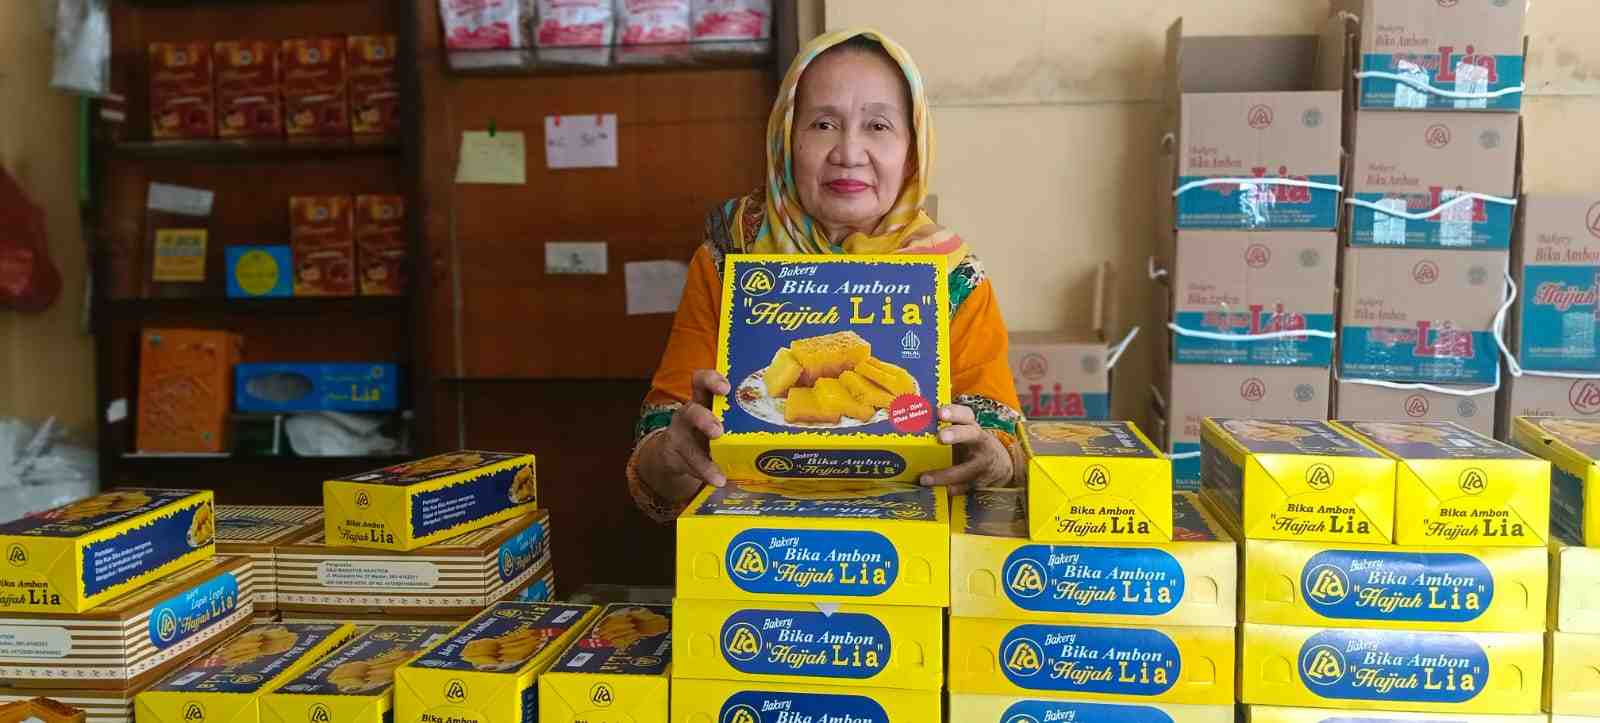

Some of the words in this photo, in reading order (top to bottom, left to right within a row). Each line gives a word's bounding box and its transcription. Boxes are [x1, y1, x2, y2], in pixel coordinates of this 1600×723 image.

[778, 265, 818, 278] Bakery
[780, 280, 828, 294] Bika
[834, 280, 911, 294] Ambon
[1029, 384, 1084, 417] Lia
[1070, 505, 1095, 515] Bika
[1098, 506, 1135, 516] Ambon
[1287, 503, 1314, 513] Bika
[1317, 504, 1356, 514] Ambon
[1440, 508, 1467, 517] Bika
[1470, 508, 1509, 517] Ambon
[1329, 515, 1370, 534] Lia
[1482, 518, 1524, 537] Lia
[371, 529, 394, 544] Lia
[768, 537, 800, 549] Bakery
[784, 548, 824, 561] Bika
[824, 550, 881, 562] Ambon
[1048, 552, 1079, 566] Bakery
[1063, 565, 1102, 578] Bika
[1106, 568, 1166, 581] Ambon
[1367, 571, 1407, 585] Bika
[1410, 573, 1474, 587] Ambon
[18, 580, 48, 588] Ambon
[29, 590, 60, 605] Lia
[763, 618, 792, 630] Bakery
[777, 630, 813, 643] Bika
[816, 631, 874, 646] Ambon
[1045, 633, 1076, 646] Bakery
[1060, 645, 1099, 659] Bika
[1102, 648, 1162, 662] Ambon
[1364, 651, 1403, 666] Bika
[1406, 653, 1469, 668] Ambon
[761, 699, 792, 712] Bakery
[775, 711, 812, 723] Bika
[816, 714, 872, 723] Ambon
[1044, 709, 1077, 722] Bakery
